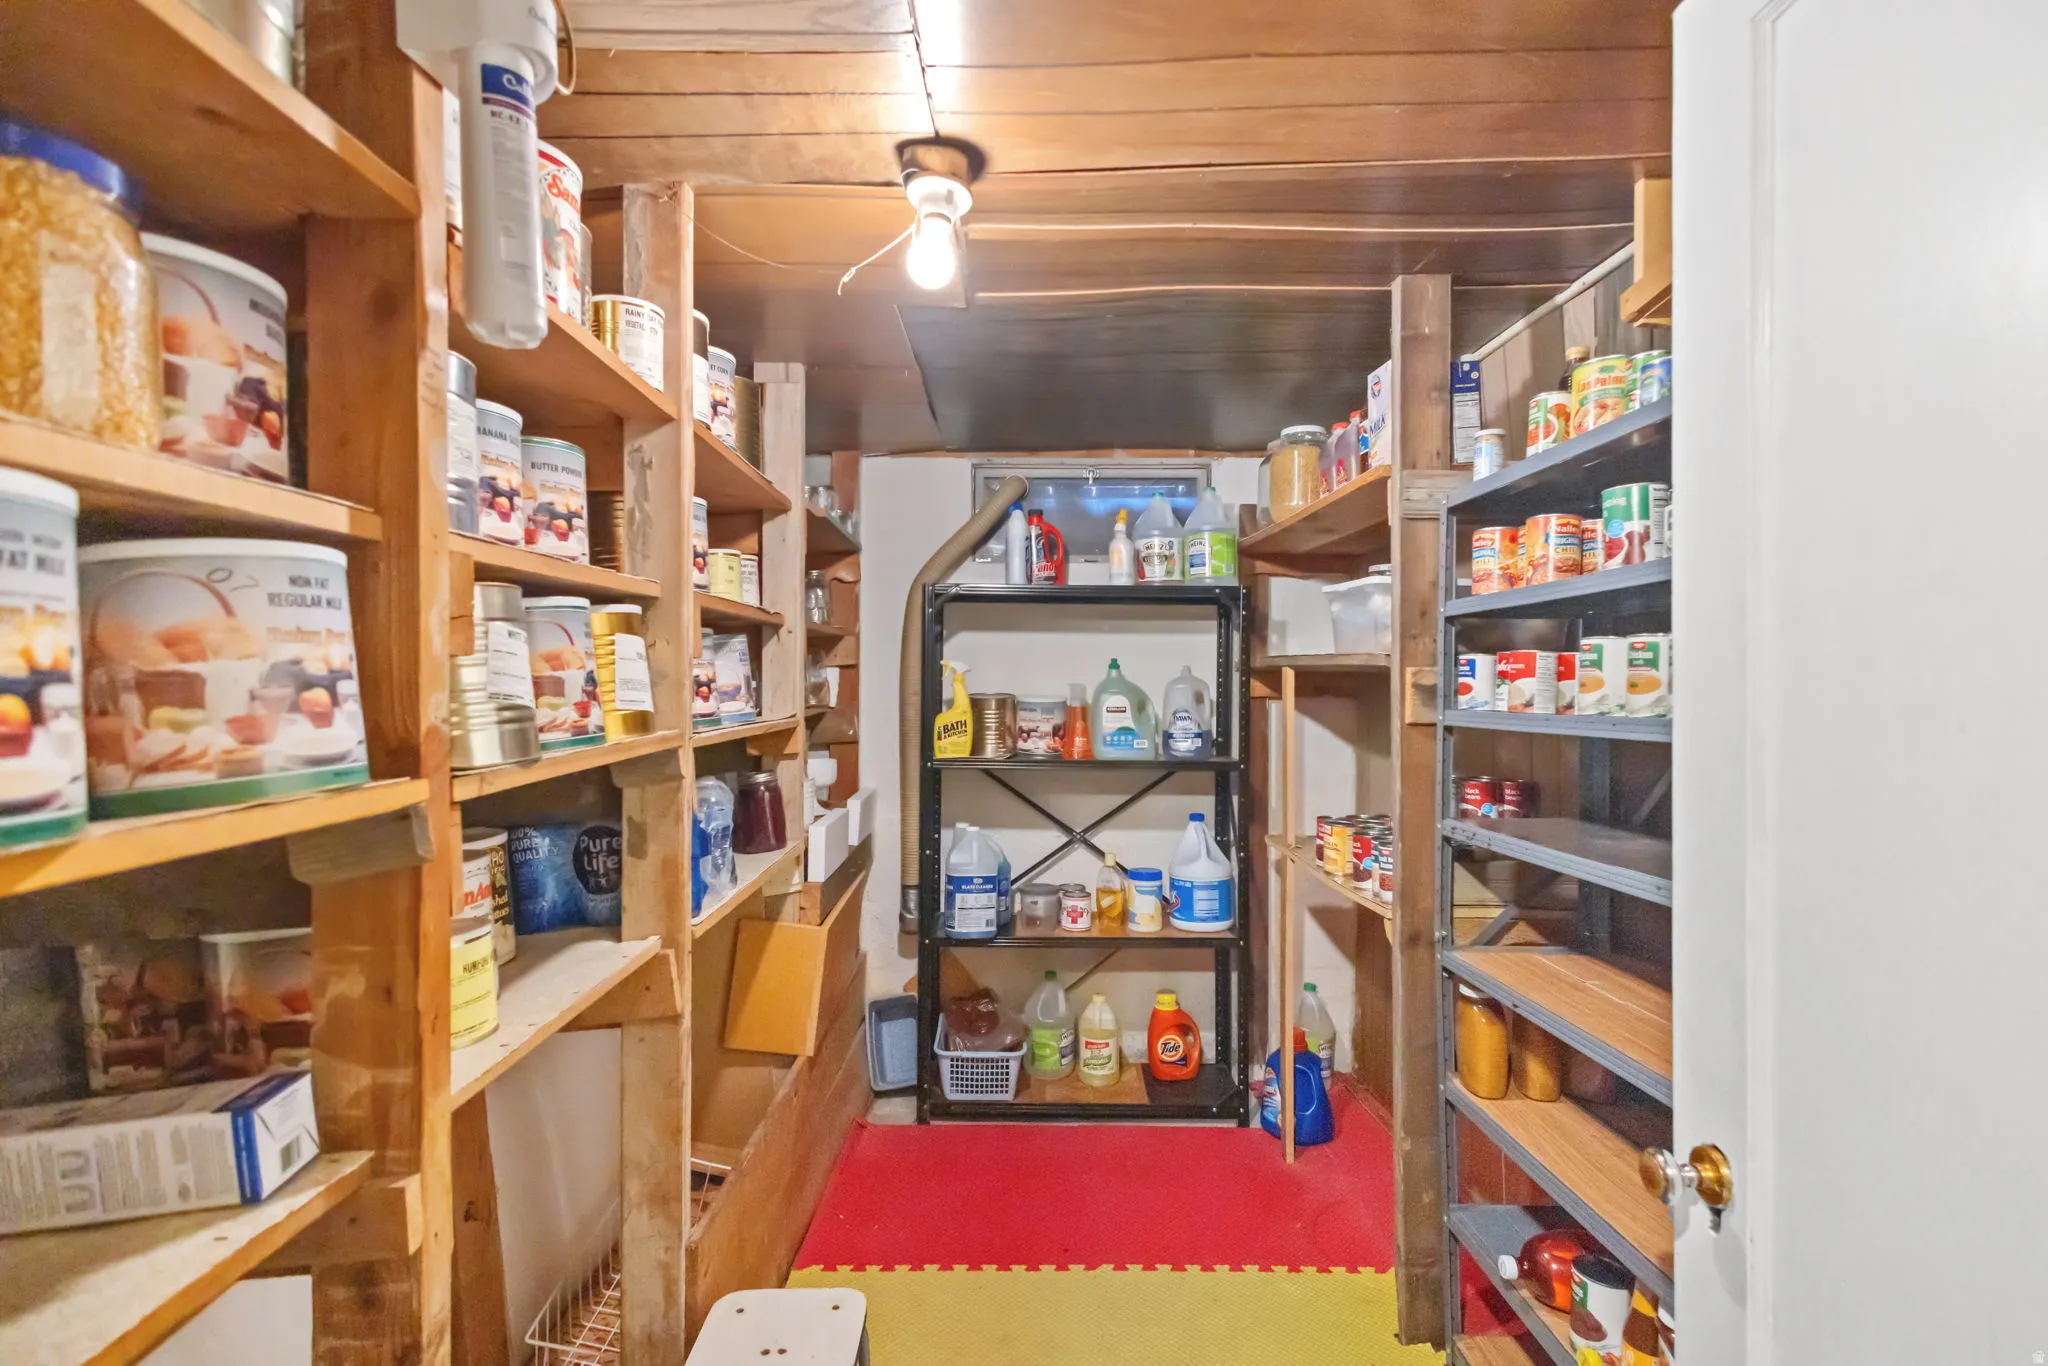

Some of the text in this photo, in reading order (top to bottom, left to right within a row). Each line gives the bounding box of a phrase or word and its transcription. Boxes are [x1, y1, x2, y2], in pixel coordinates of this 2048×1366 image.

[625, 308, 645, 320] RAINY
[717, 365, 729, 376] CORN
[1577, 380, 1592, 393] Las
[1369, 415, 1386, 435] MILK
[477, 426, 508, 441] BANANA
[530, 461, 559, 473] BUTTER
[1145, 540, 1165, 551] HEZ
[267, 592, 322, 609] REGULAR
[942, 719, 967, 734] BATH
[947, 729, 968, 740] KITCHEN
[580, 834, 622, 853] Pure
[512, 846, 560, 863] QUALITY
[584, 853, 621, 874] Life
[1161, 1042, 1181, 1055] Tide
